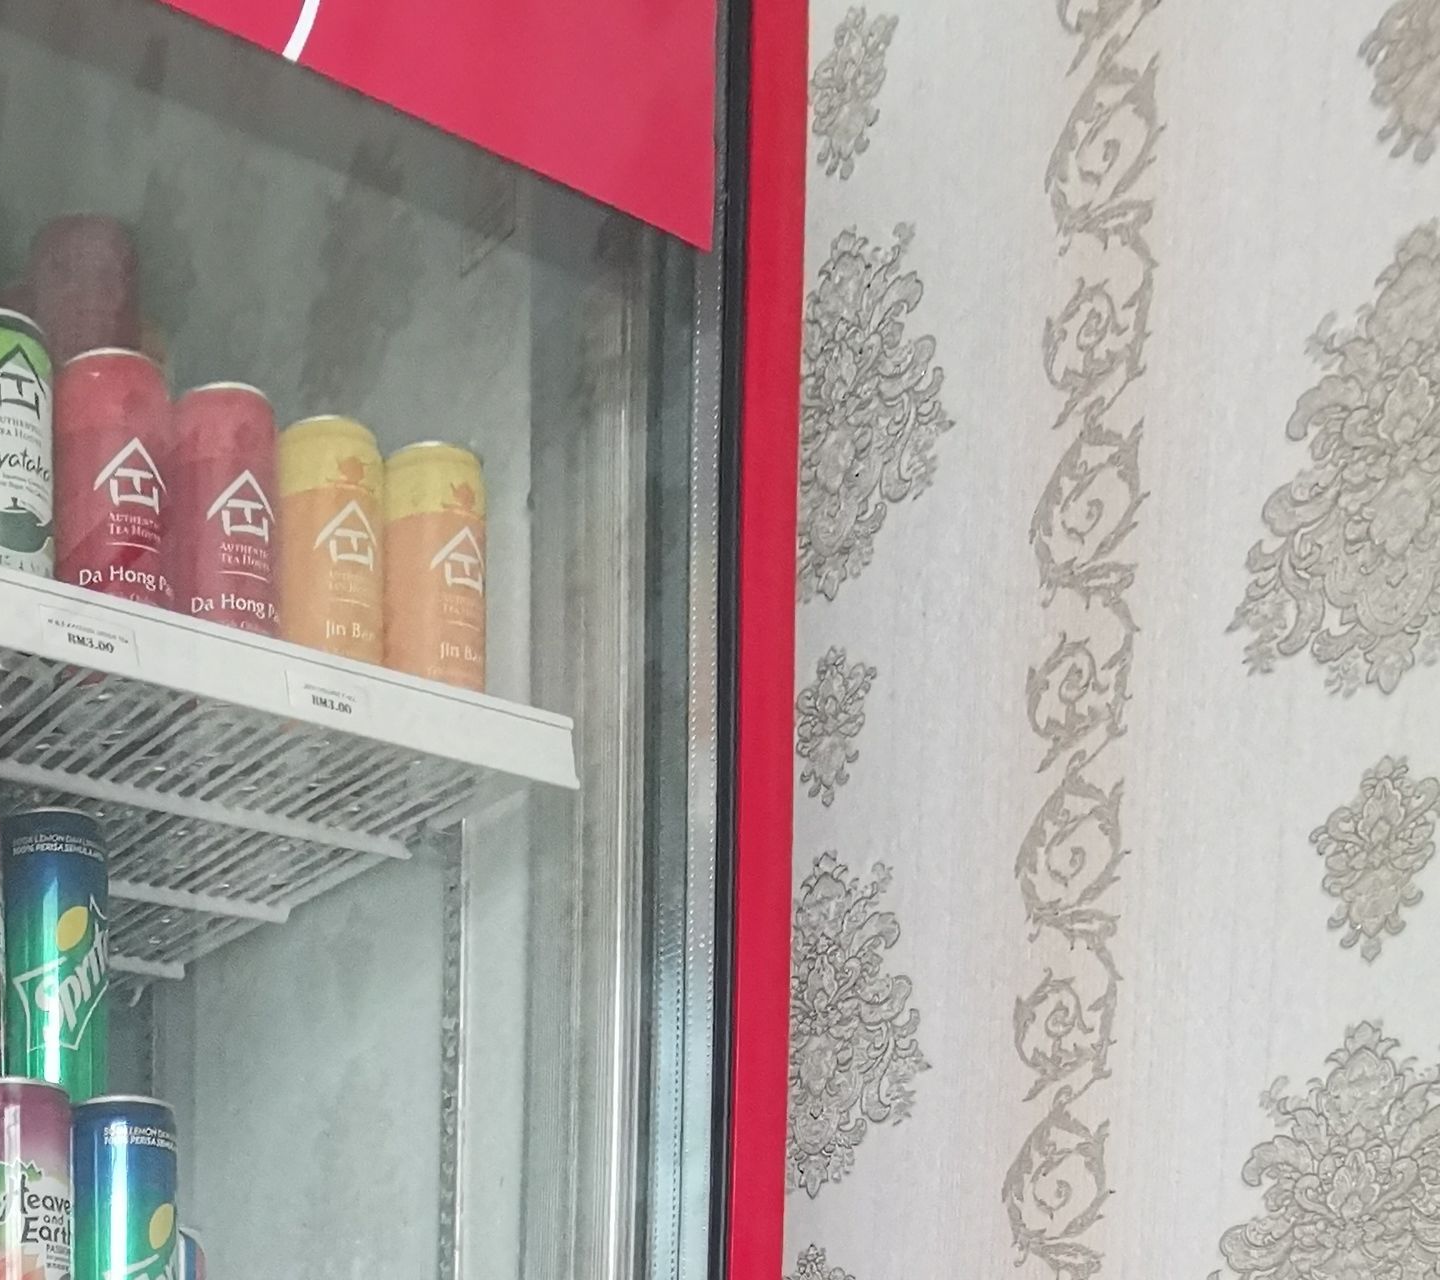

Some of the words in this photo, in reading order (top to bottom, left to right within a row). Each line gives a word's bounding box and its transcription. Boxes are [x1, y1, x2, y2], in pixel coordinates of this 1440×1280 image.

[79, 567, 102, 587] Da
[110, 564, 156, 591] Hong
[191, 596, 214, 614] Da
[221, 593, 265, 619] Hong
[326, 619, 346, 638] Jin
[67, 632, 114, 654] RM3.00
[440, 642, 460, 659] Jin
[311, 694, 352, 715] RM3.00
[43, 1214, 64, 1226] and
